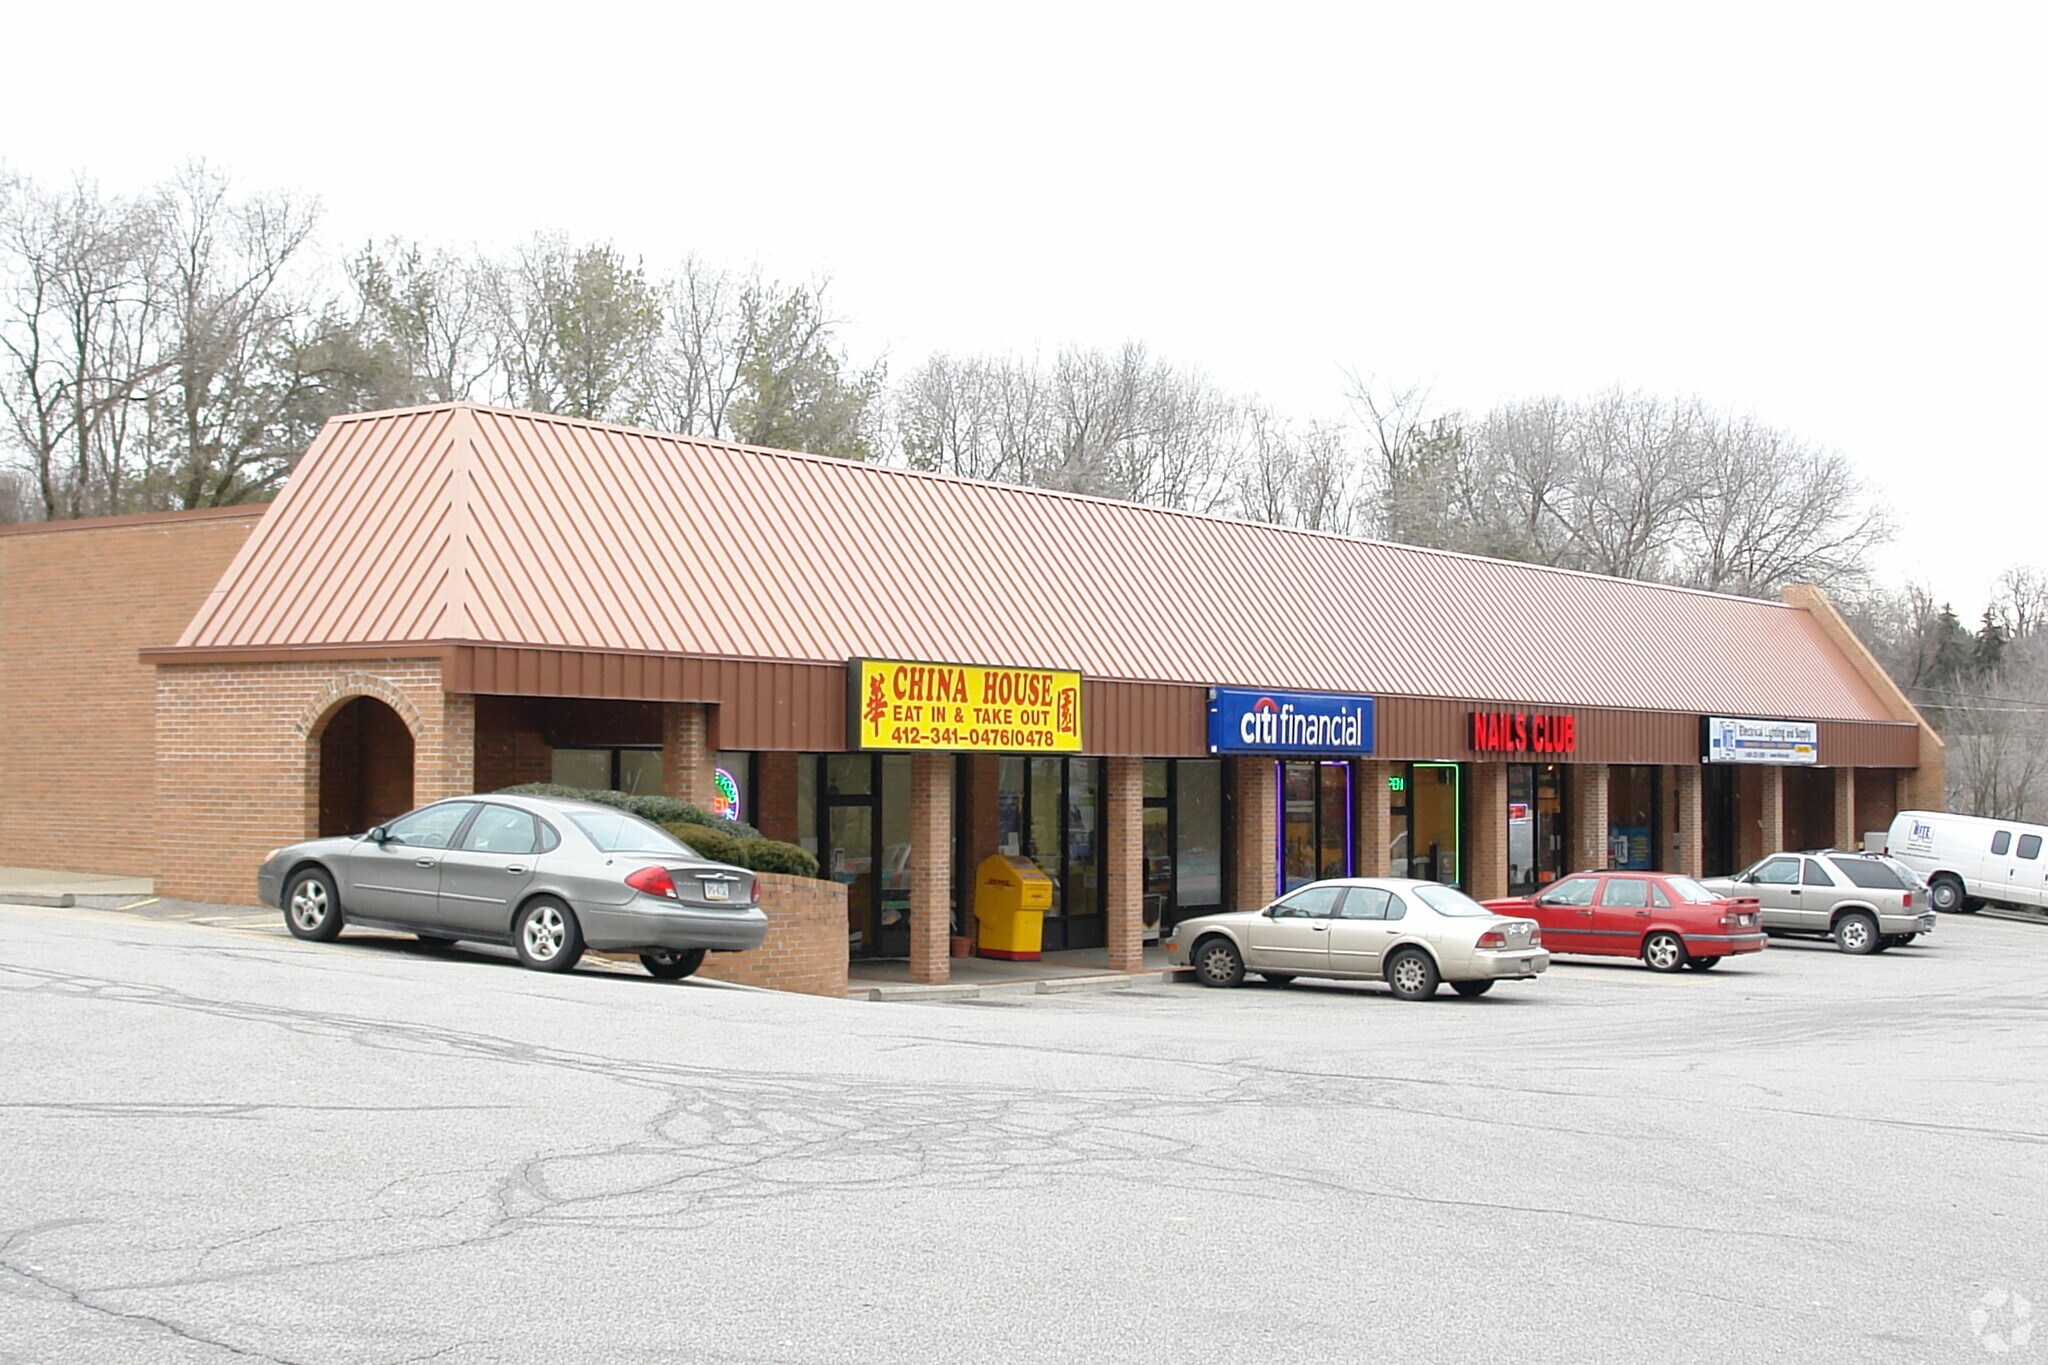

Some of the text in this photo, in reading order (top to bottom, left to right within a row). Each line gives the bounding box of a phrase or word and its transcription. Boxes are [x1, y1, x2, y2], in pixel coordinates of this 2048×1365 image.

[892, 665, 1053, 707] CHINA HOUSE
[893, 705, 1050, 726] EAT IN & TAKE OUT
[1474, 711, 1576, 752] NAILS CLUB
